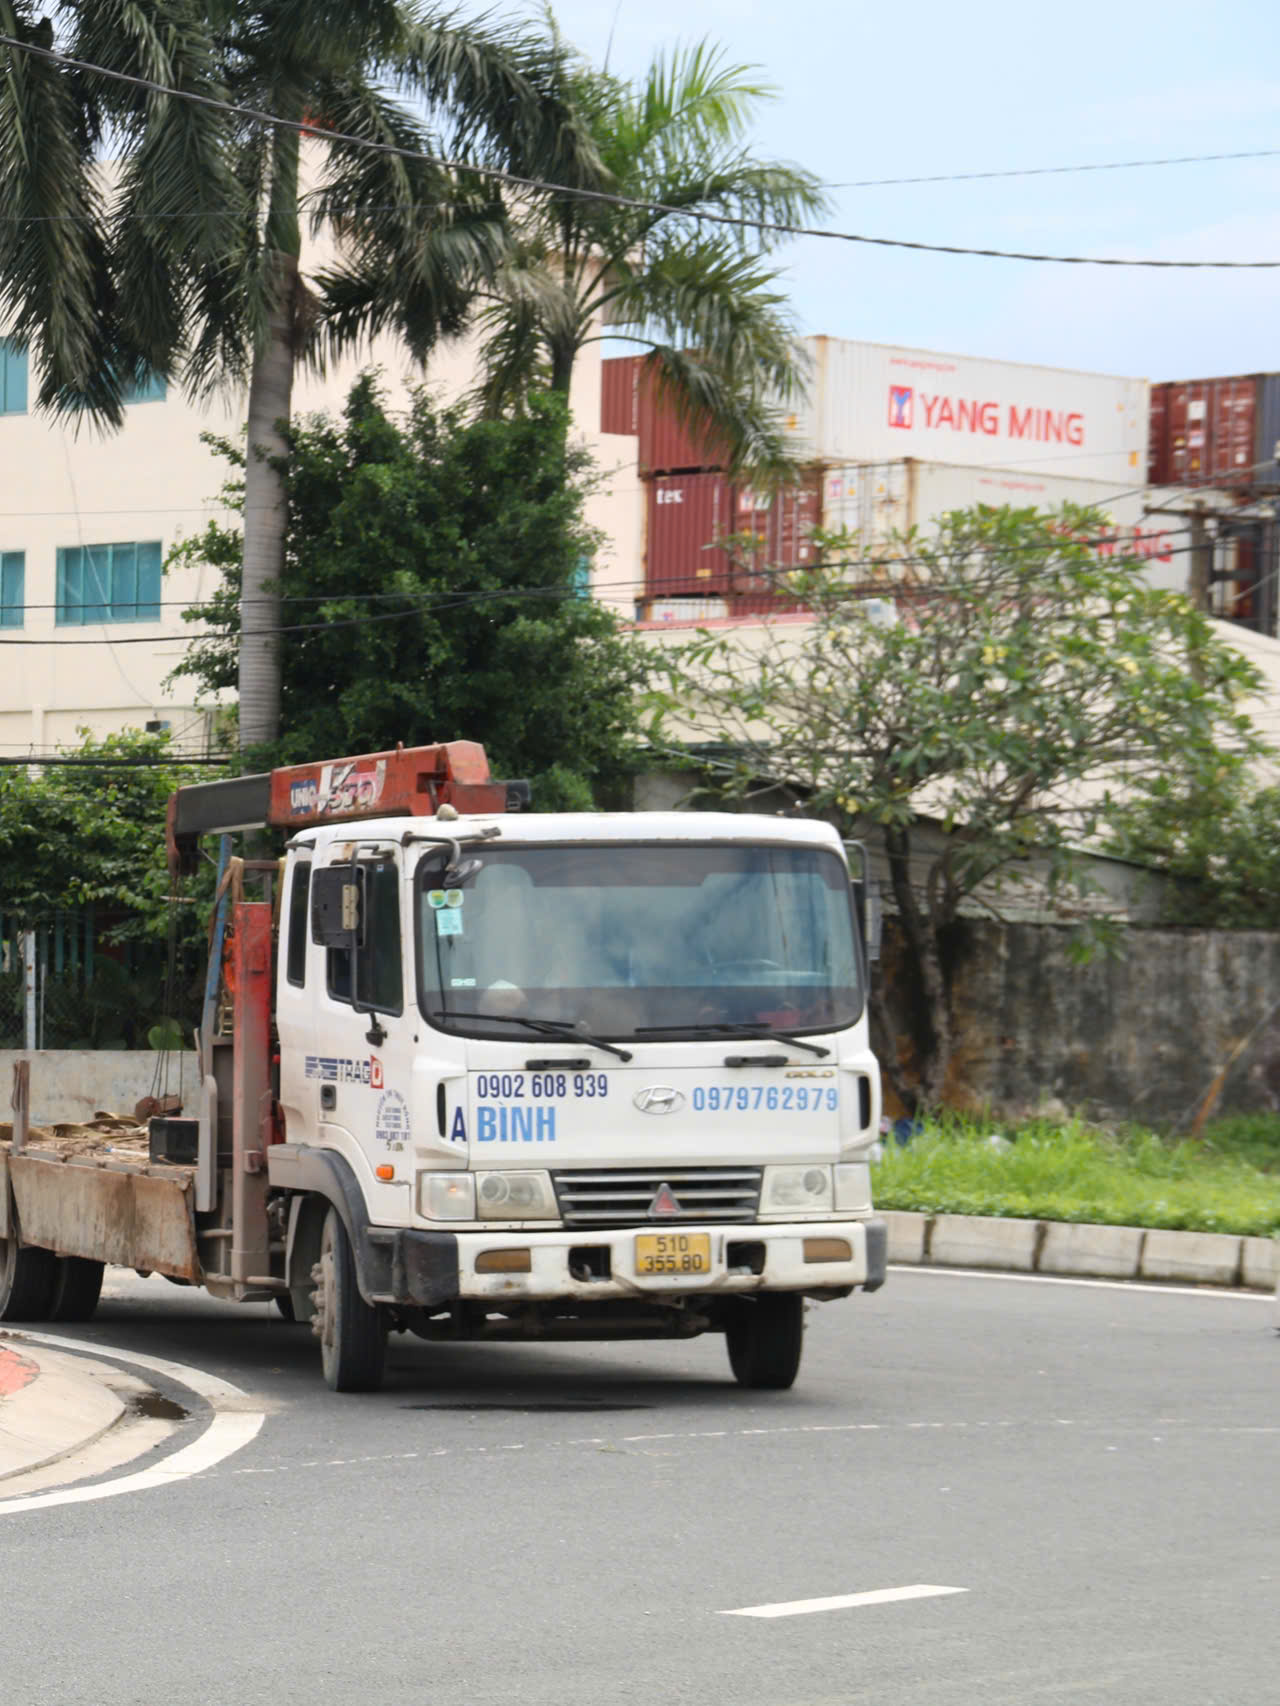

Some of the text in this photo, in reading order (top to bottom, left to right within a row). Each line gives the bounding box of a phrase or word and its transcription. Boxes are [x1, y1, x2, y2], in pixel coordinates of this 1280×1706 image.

[920, 393, 1085, 446] YANG MING
[476, 1073, 609, 1099] 0902 608 939
[692, 1086, 839, 1112] 0979762979
[450, 1106, 468, 1142] A
[476, 1101, 556, 1142] BÌNH
